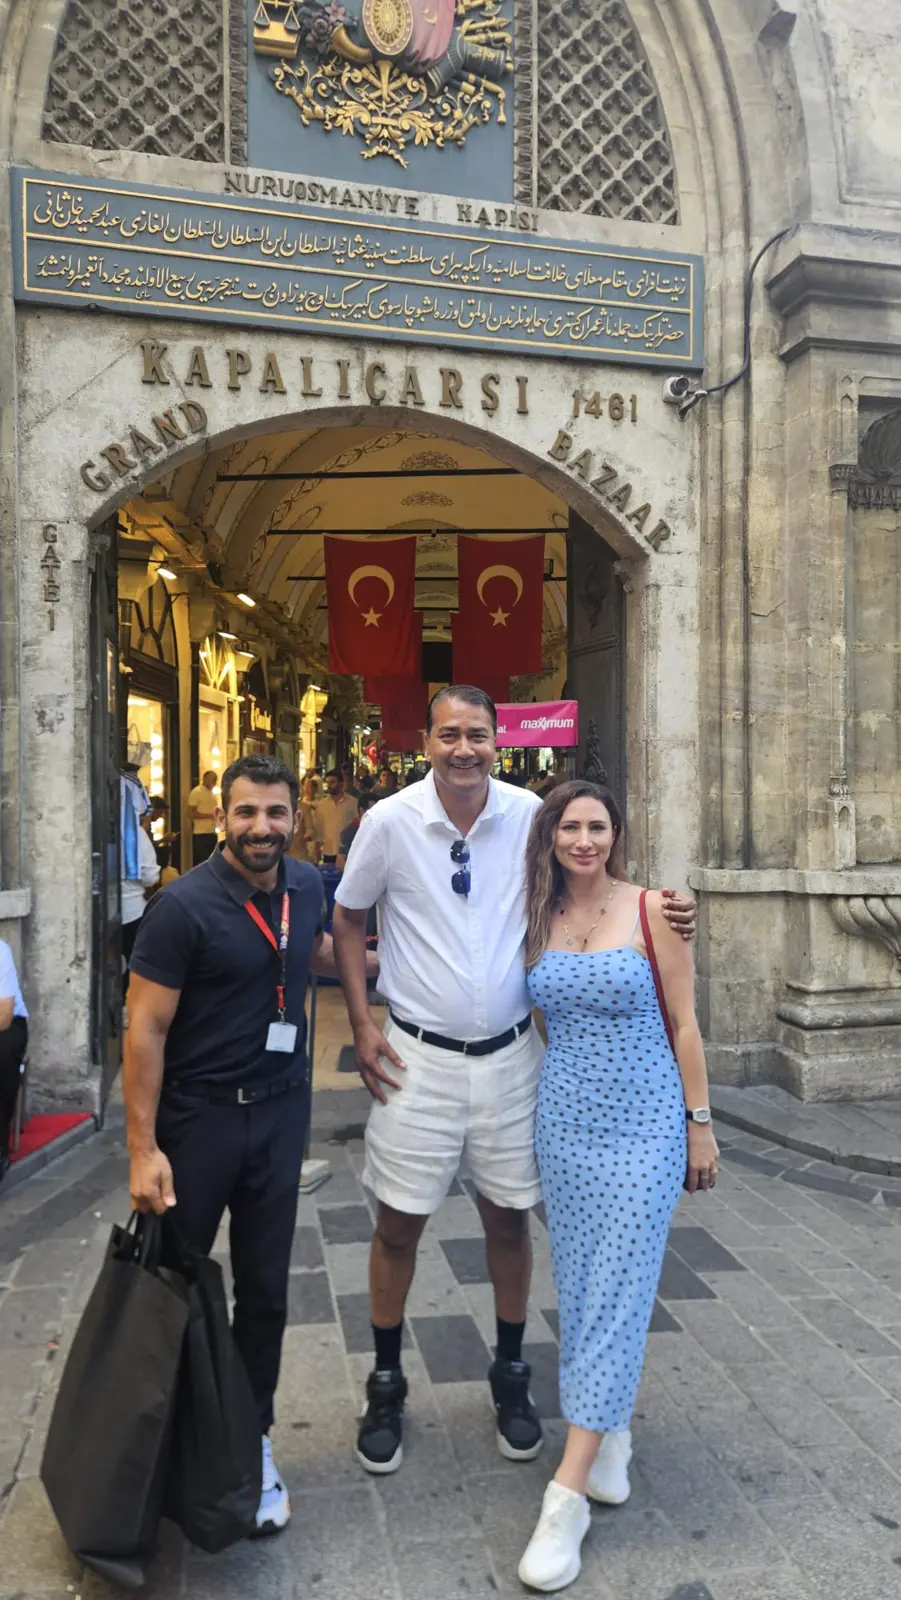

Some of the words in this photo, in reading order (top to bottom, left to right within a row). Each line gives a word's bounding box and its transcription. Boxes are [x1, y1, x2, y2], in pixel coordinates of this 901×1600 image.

[140, 341, 528, 417] KAPALIÇARŞI
[572, 388, 638, 423] 1461
[80, 399, 208, 492] GRAND
[547, 428, 672, 552] BAZAAR
[41, 523, 61, 603] GATE
[520, 716, 574, 731] maximum
